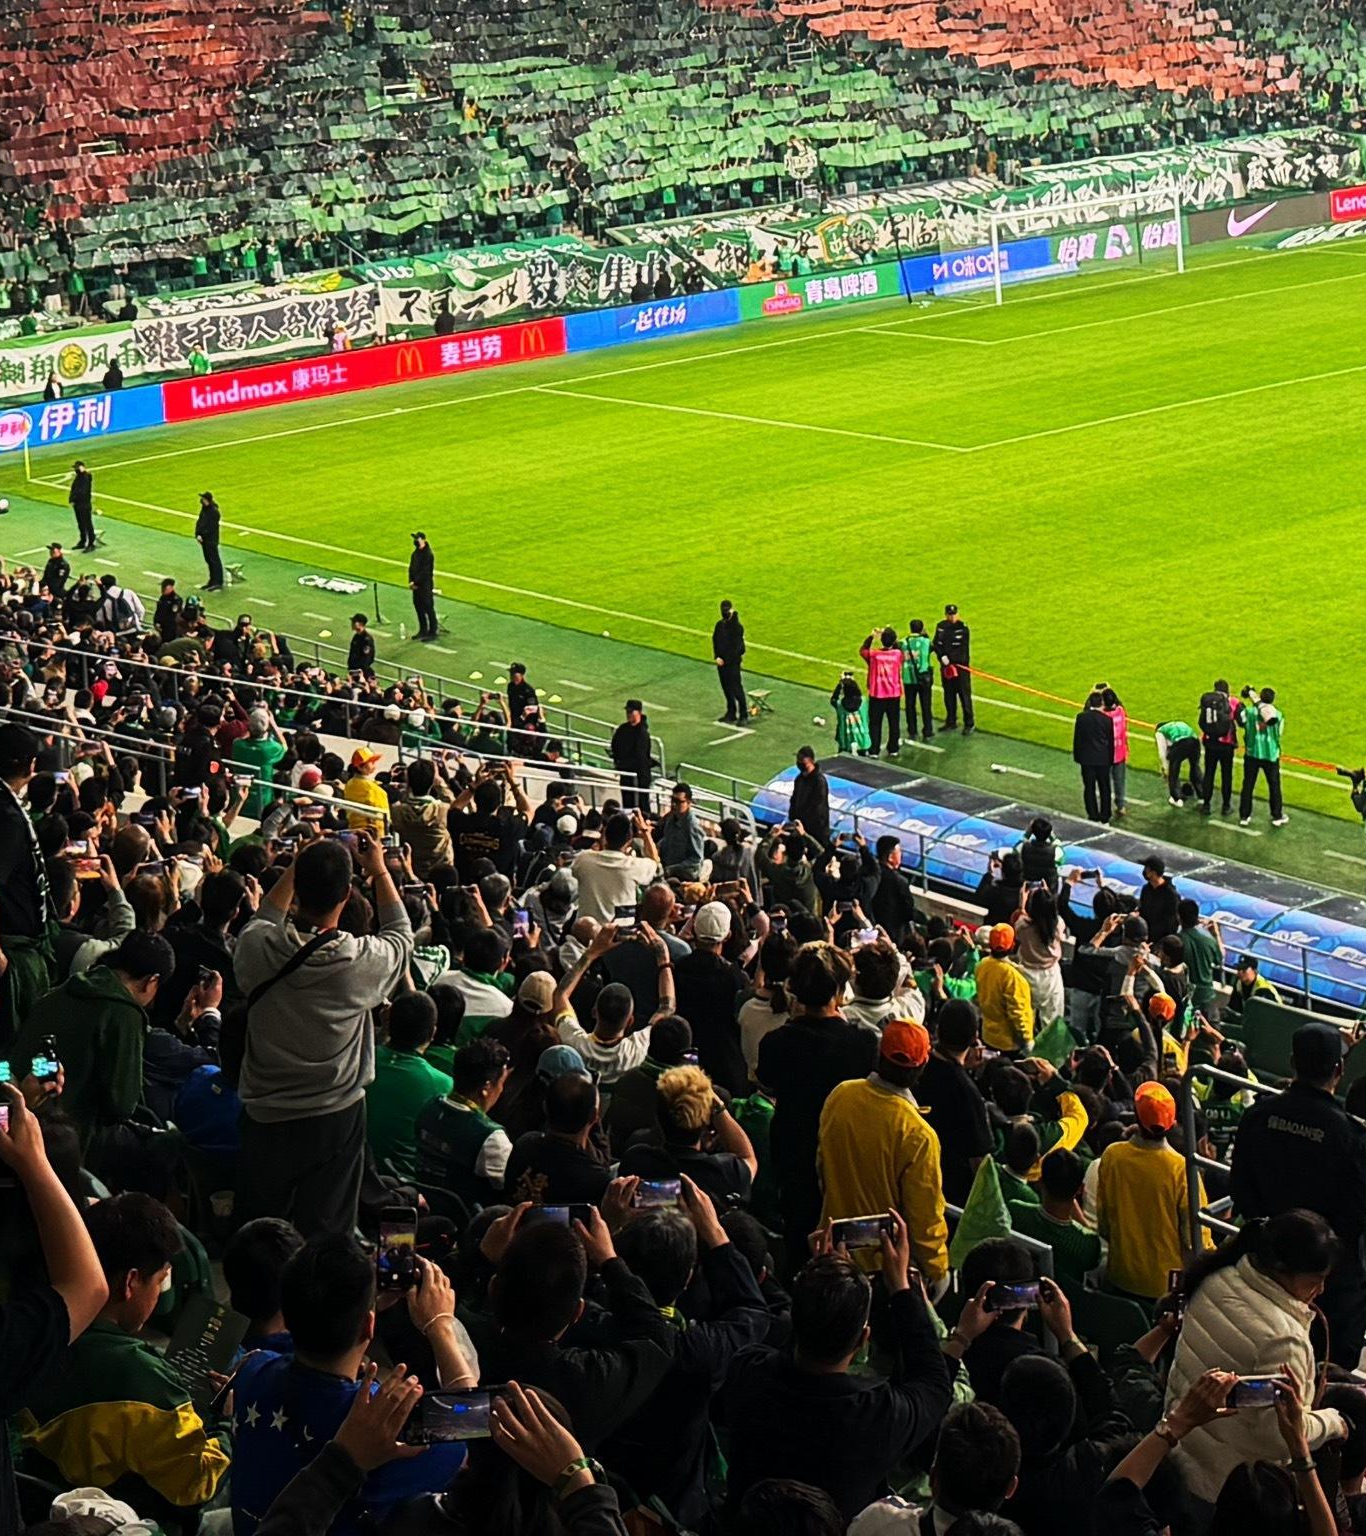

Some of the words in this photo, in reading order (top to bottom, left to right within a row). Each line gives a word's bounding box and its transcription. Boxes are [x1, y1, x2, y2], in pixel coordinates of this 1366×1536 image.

[441, 334, 502, 367] 麦当劳
[191, 379, 288, 409] kindmax
[39, 395, 112, 441] 伊利
